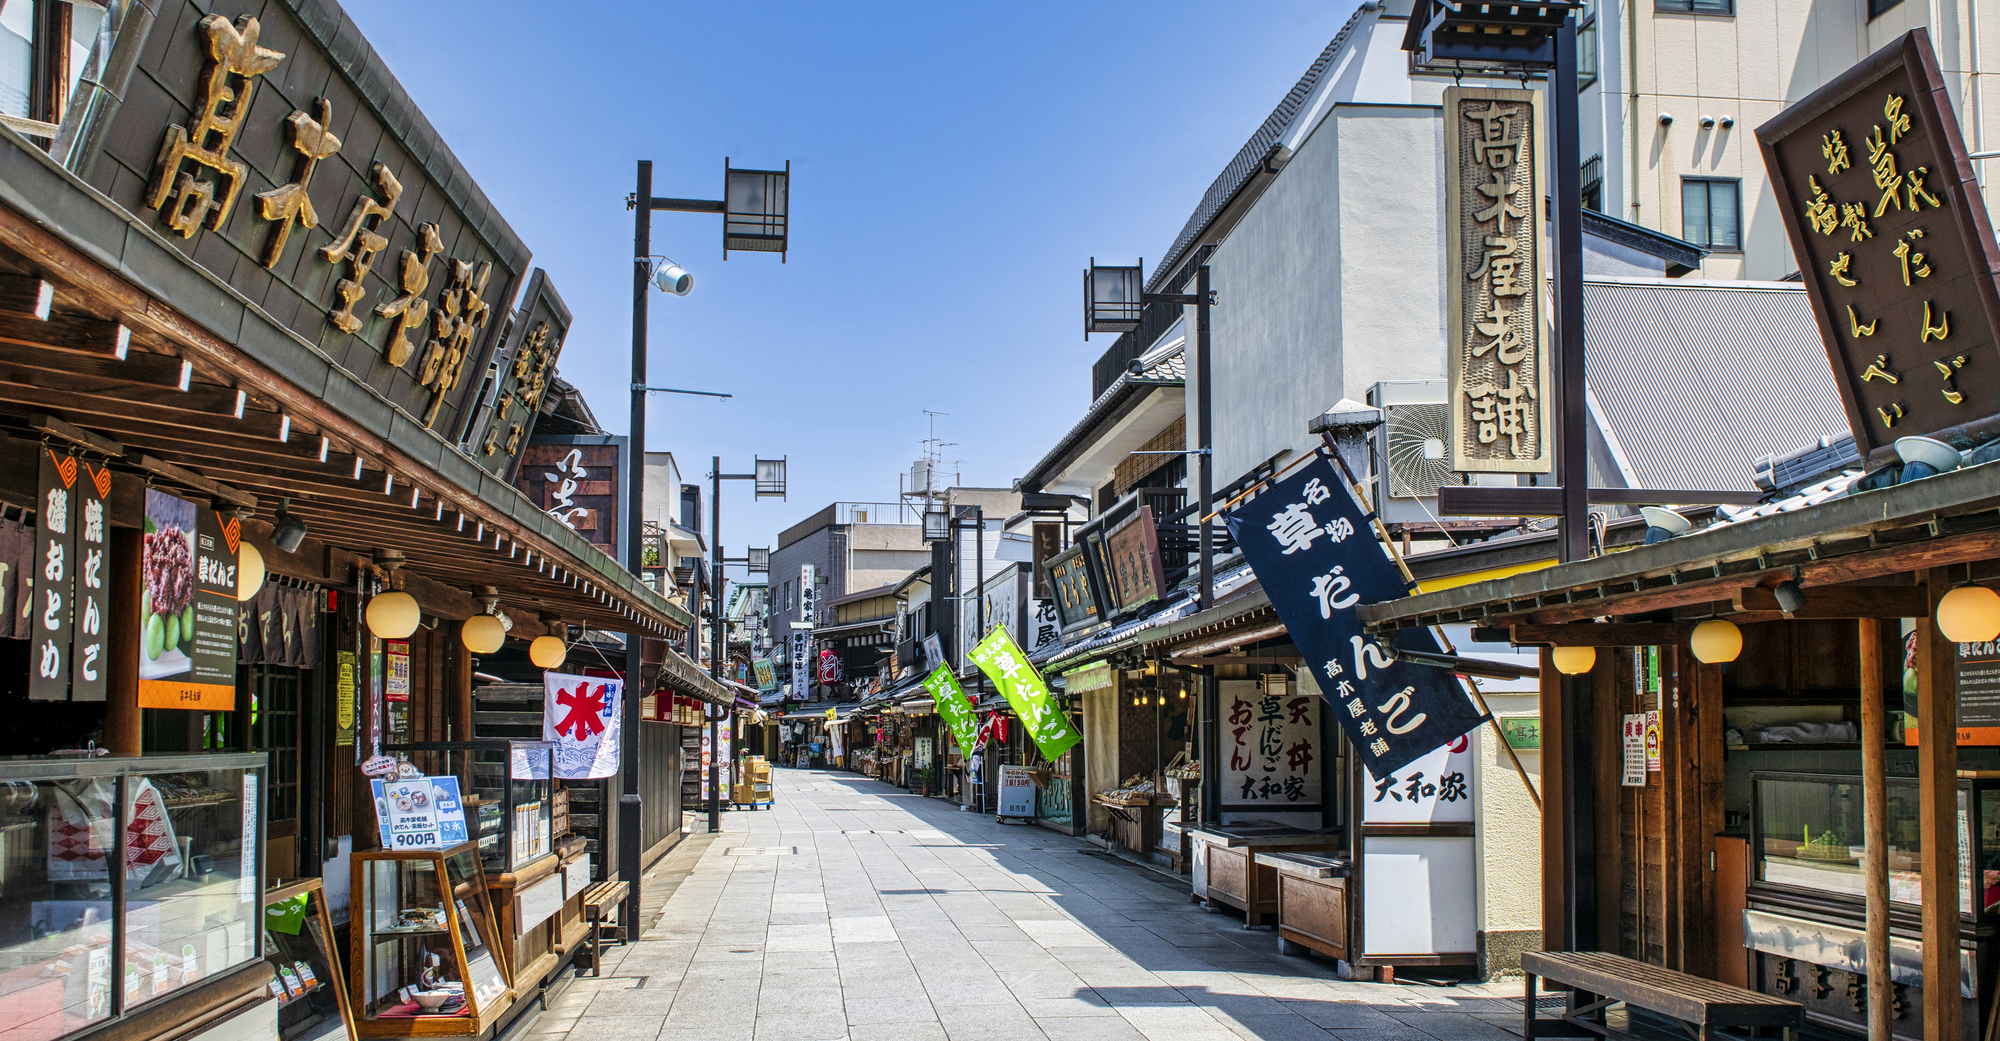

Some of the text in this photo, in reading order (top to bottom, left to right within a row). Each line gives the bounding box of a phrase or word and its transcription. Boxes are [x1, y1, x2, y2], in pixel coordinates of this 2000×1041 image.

[1303, 478, 1354, 543] 名物
[40, 488, 67, 679] 磯おとめ
[82, 498, 104, 682] 焼だんご
[198, 555, 236, 588] 草だんご
[1266, 503, 1427, 735] 草だんご
[1958, 639, 2000, 658] 草だん
[993, 651, 1066, 740] 草だんご
[1021, 711, 1047, 744] とらや
[1228, 695, 1253, 772] おでん
[1257, 697, 1285, 773] 草だんご
[1286, 697, 1314, 777] 天丼
[1241, 774, 1307, 801] 大和家
[1373, 771, 1469, 804] 大和家
[396, 832, 436, 846] 900円
[439, 821, 461, 832] き氷
